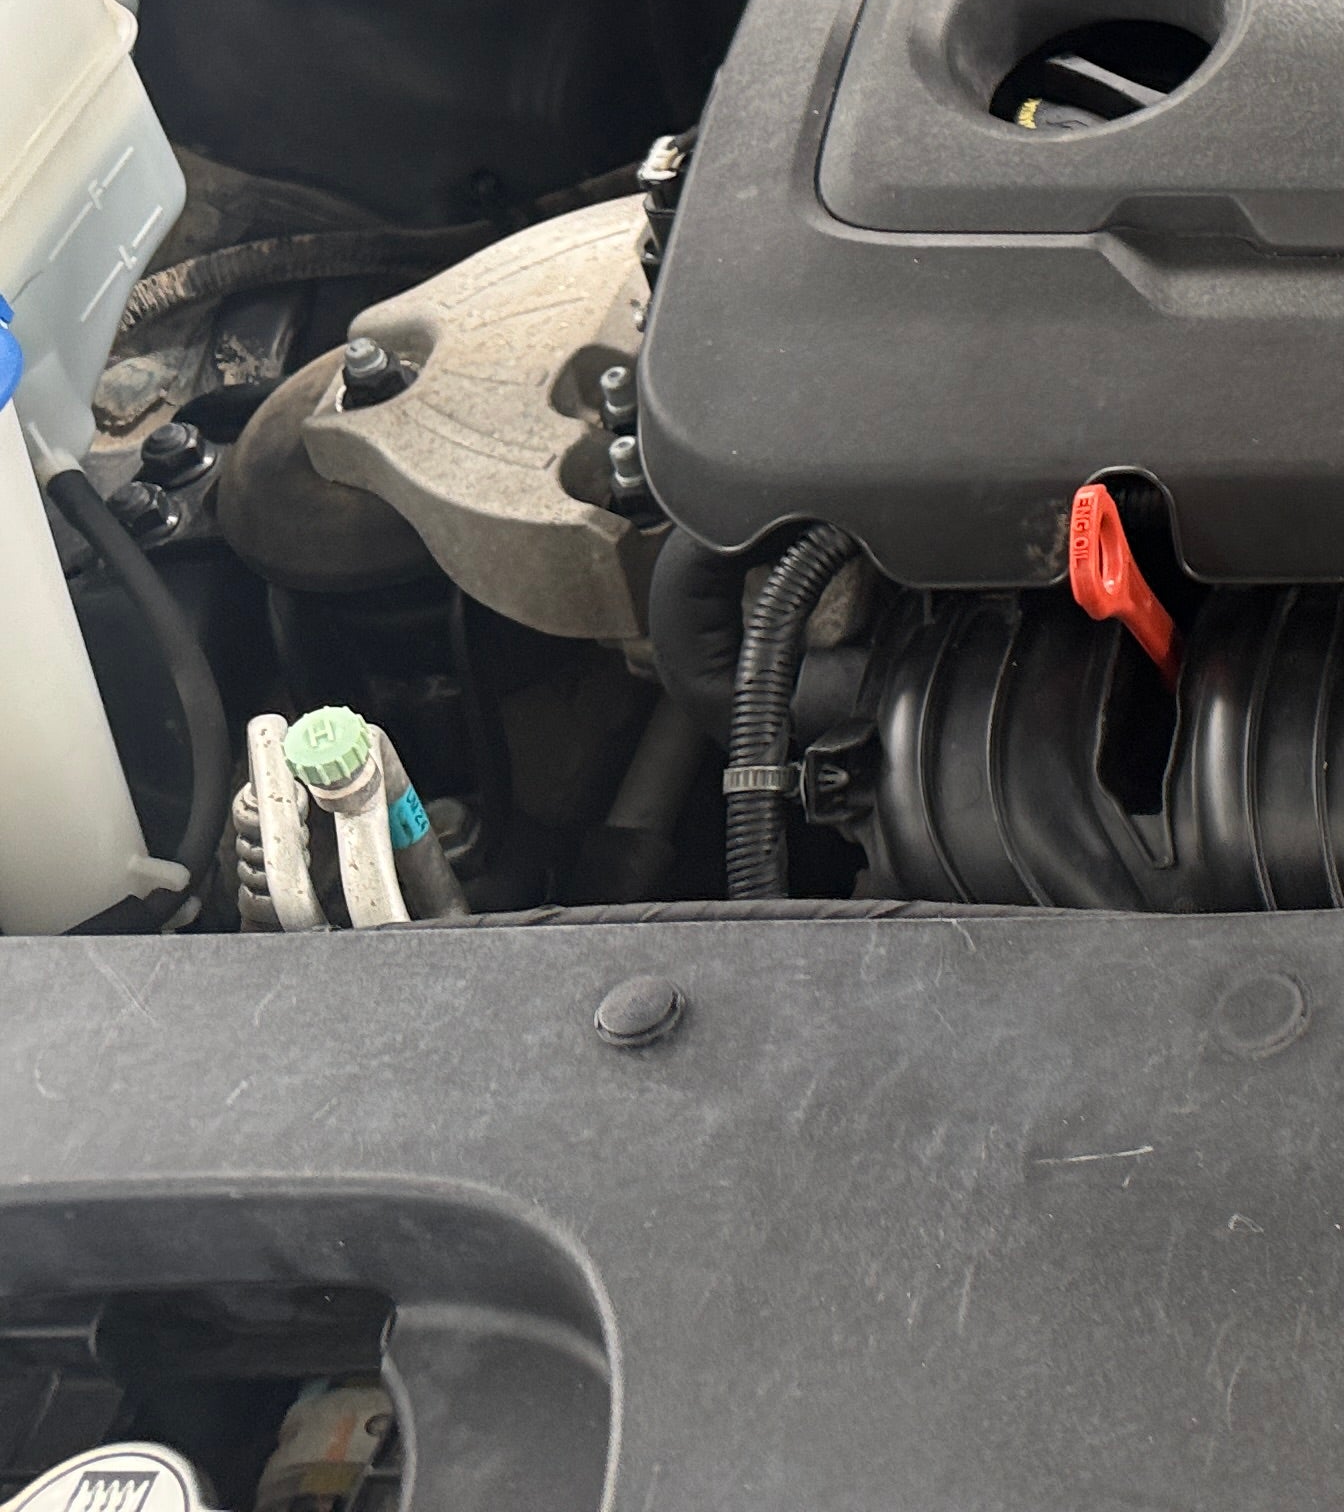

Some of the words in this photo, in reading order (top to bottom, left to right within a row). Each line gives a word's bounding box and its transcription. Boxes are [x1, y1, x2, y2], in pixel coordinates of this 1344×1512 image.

[1073, 492, 1095, 533] ENG
[1073, 537, 1089, 568] OIL
[307, 720, 336, 748] H
